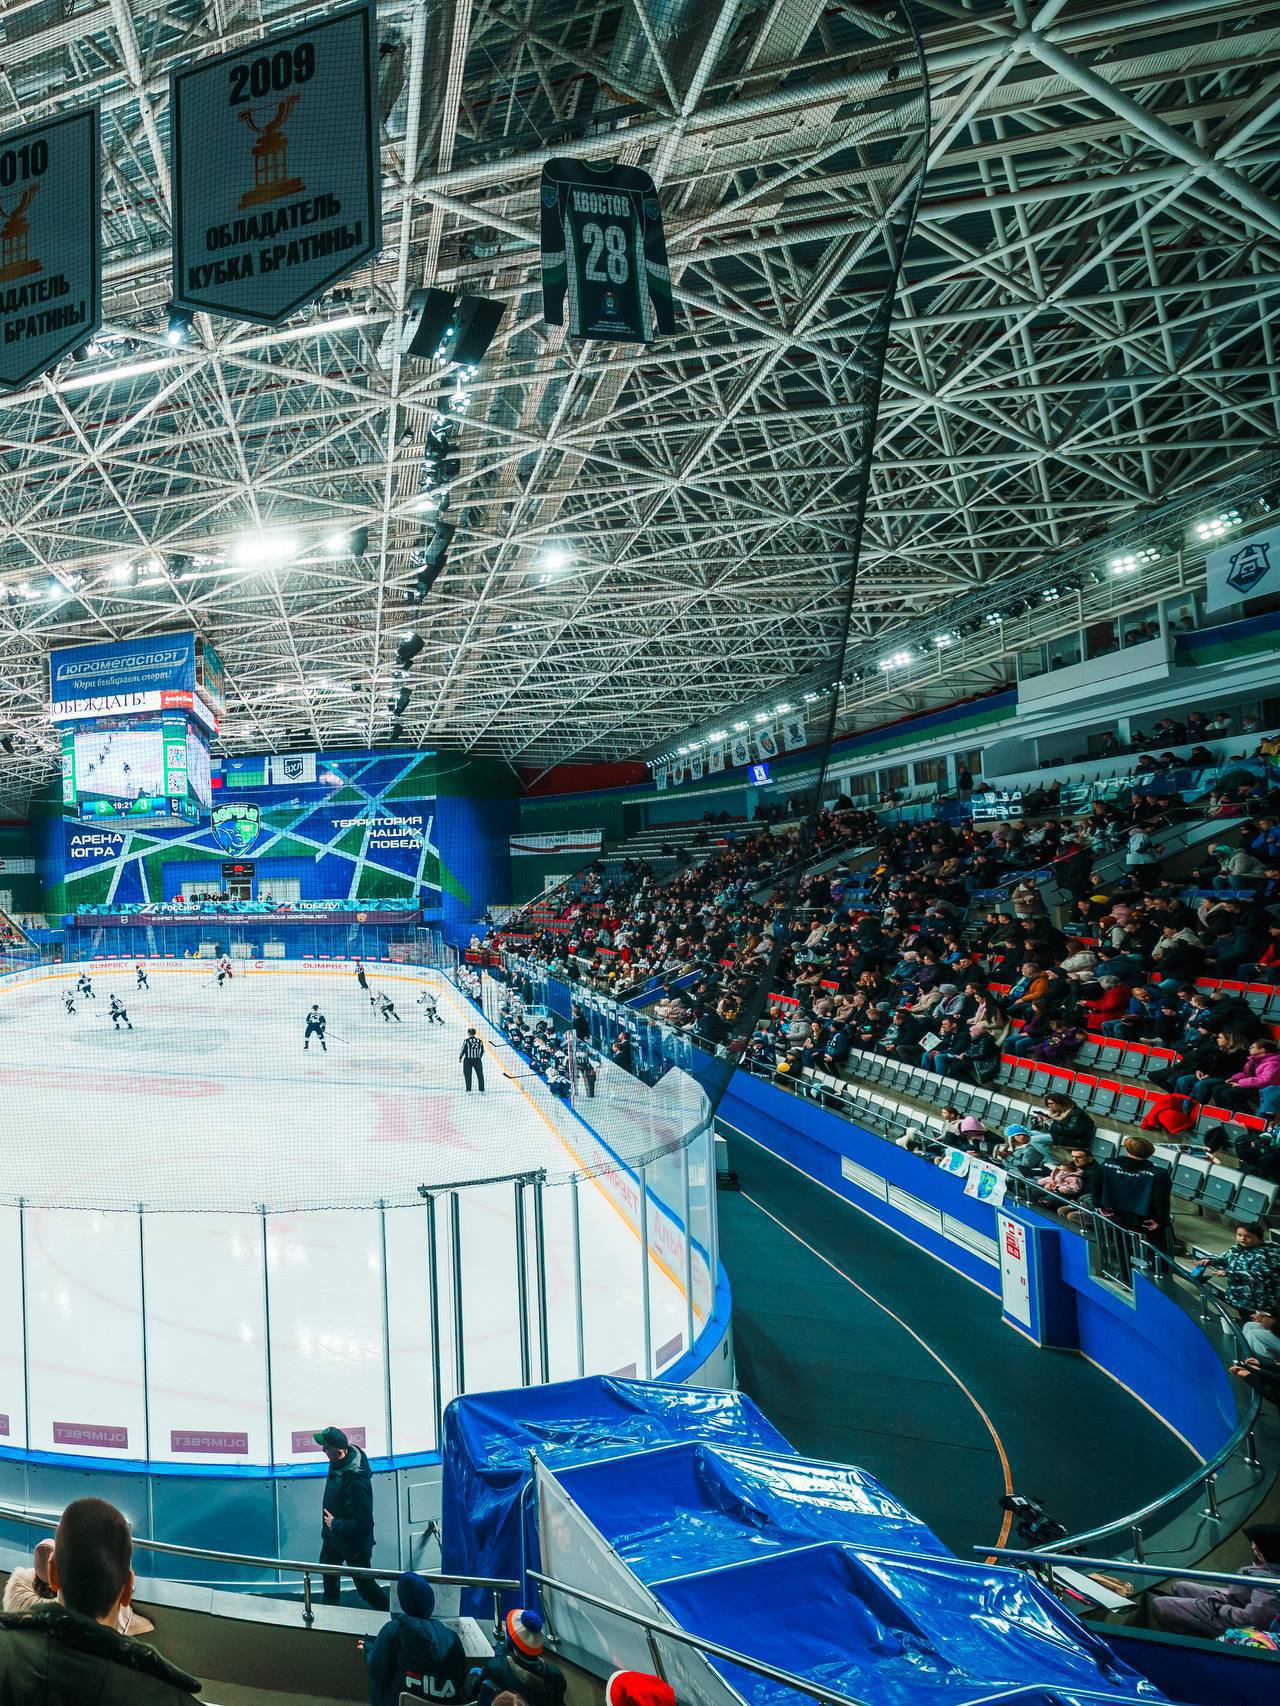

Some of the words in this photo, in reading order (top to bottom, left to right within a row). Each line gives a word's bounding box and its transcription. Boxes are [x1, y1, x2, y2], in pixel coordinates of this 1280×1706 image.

[229, 42, 315, 106] 2009
[573, 190, 630, 217] ХВОСТОВ
[206, 193, 341, 251] ОБЛАДАТЕЛЬ
[189, 254, 254, 291] КУБКА
[259, 220, 363, 274] БРАТИНЫ
[582, 222, 629, 284] 28
[5, 300, 86, 344] БРАТИНЫ
[284, 761, 303, 774] ВХЛ
[100, 802, 106, 812] 3
[141, 799, 147, 809] 3
[331, 816, 423, 828] ТЕРРИТОРИЯ
[70, 833, 124, 846] АРЕНА
[367, 827, 423, 837] НАШИХ
[71, 847, 115, 858] ЮГРА
[370, 839, 424, 849] ПОБЕД!
[405, 1671, 455, 1697] FILA
